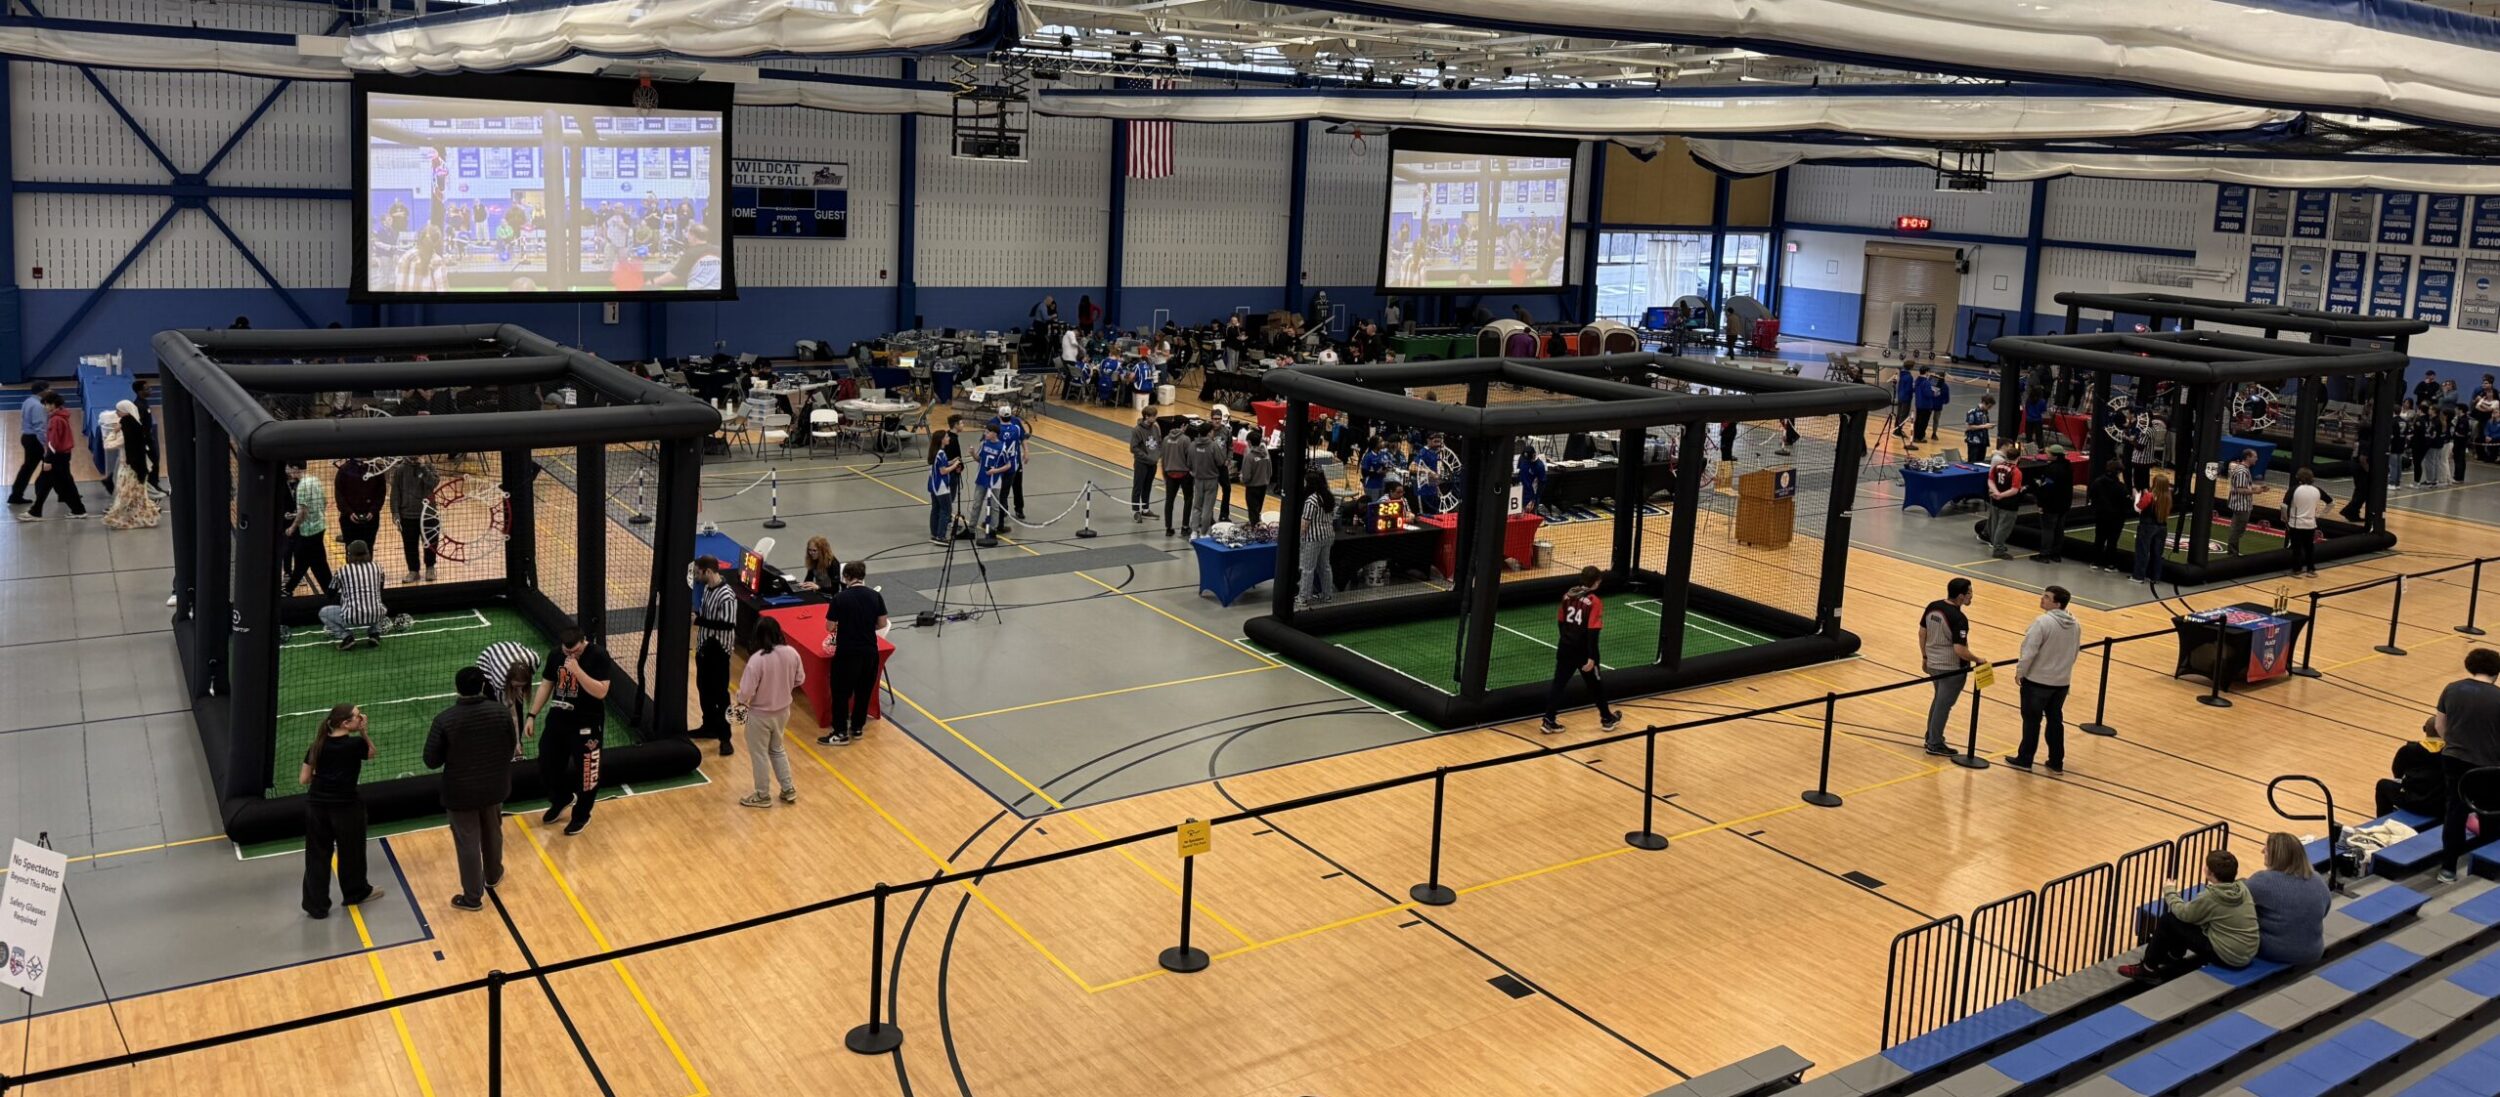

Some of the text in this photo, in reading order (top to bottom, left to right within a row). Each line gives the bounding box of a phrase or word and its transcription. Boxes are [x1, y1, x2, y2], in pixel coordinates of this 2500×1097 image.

[736, 162, 801, 174] WILDCAT
[732, 174, 808, 186] OLLEYBALL
[814, 210, 846, 220] GUEST
[2220, 221, 2240, 230] 2009
[2300, 226, 2320, 235] 2010
[2384, 232, 2407, 240] 2010
[2430, 235, 2452, 243] 2010
[2477, 238, 2500, 246] 2010
[2332, 305, 2353, 314] 2017
[2419, 301, 2447, 310] CHAMPIONS
[2375, 309, 2397, 317] 2018
[2420, 313, 2442, 322] 2019
[2467, 318, 2489, 327] 2019
[1510, 497, 1518, 510] B
[1379, 502, 1399, 516] 2:22
[1566, 606, 1582, 626] 24
[590, 748, 600, 790] UTICA
[13, 854, 59, 878] No Spectators
[11, 872, 57, 894] Beyond This Point
[10, 897, 46, 917] Safety Glasses
[13, 911, 38, 926] Required
